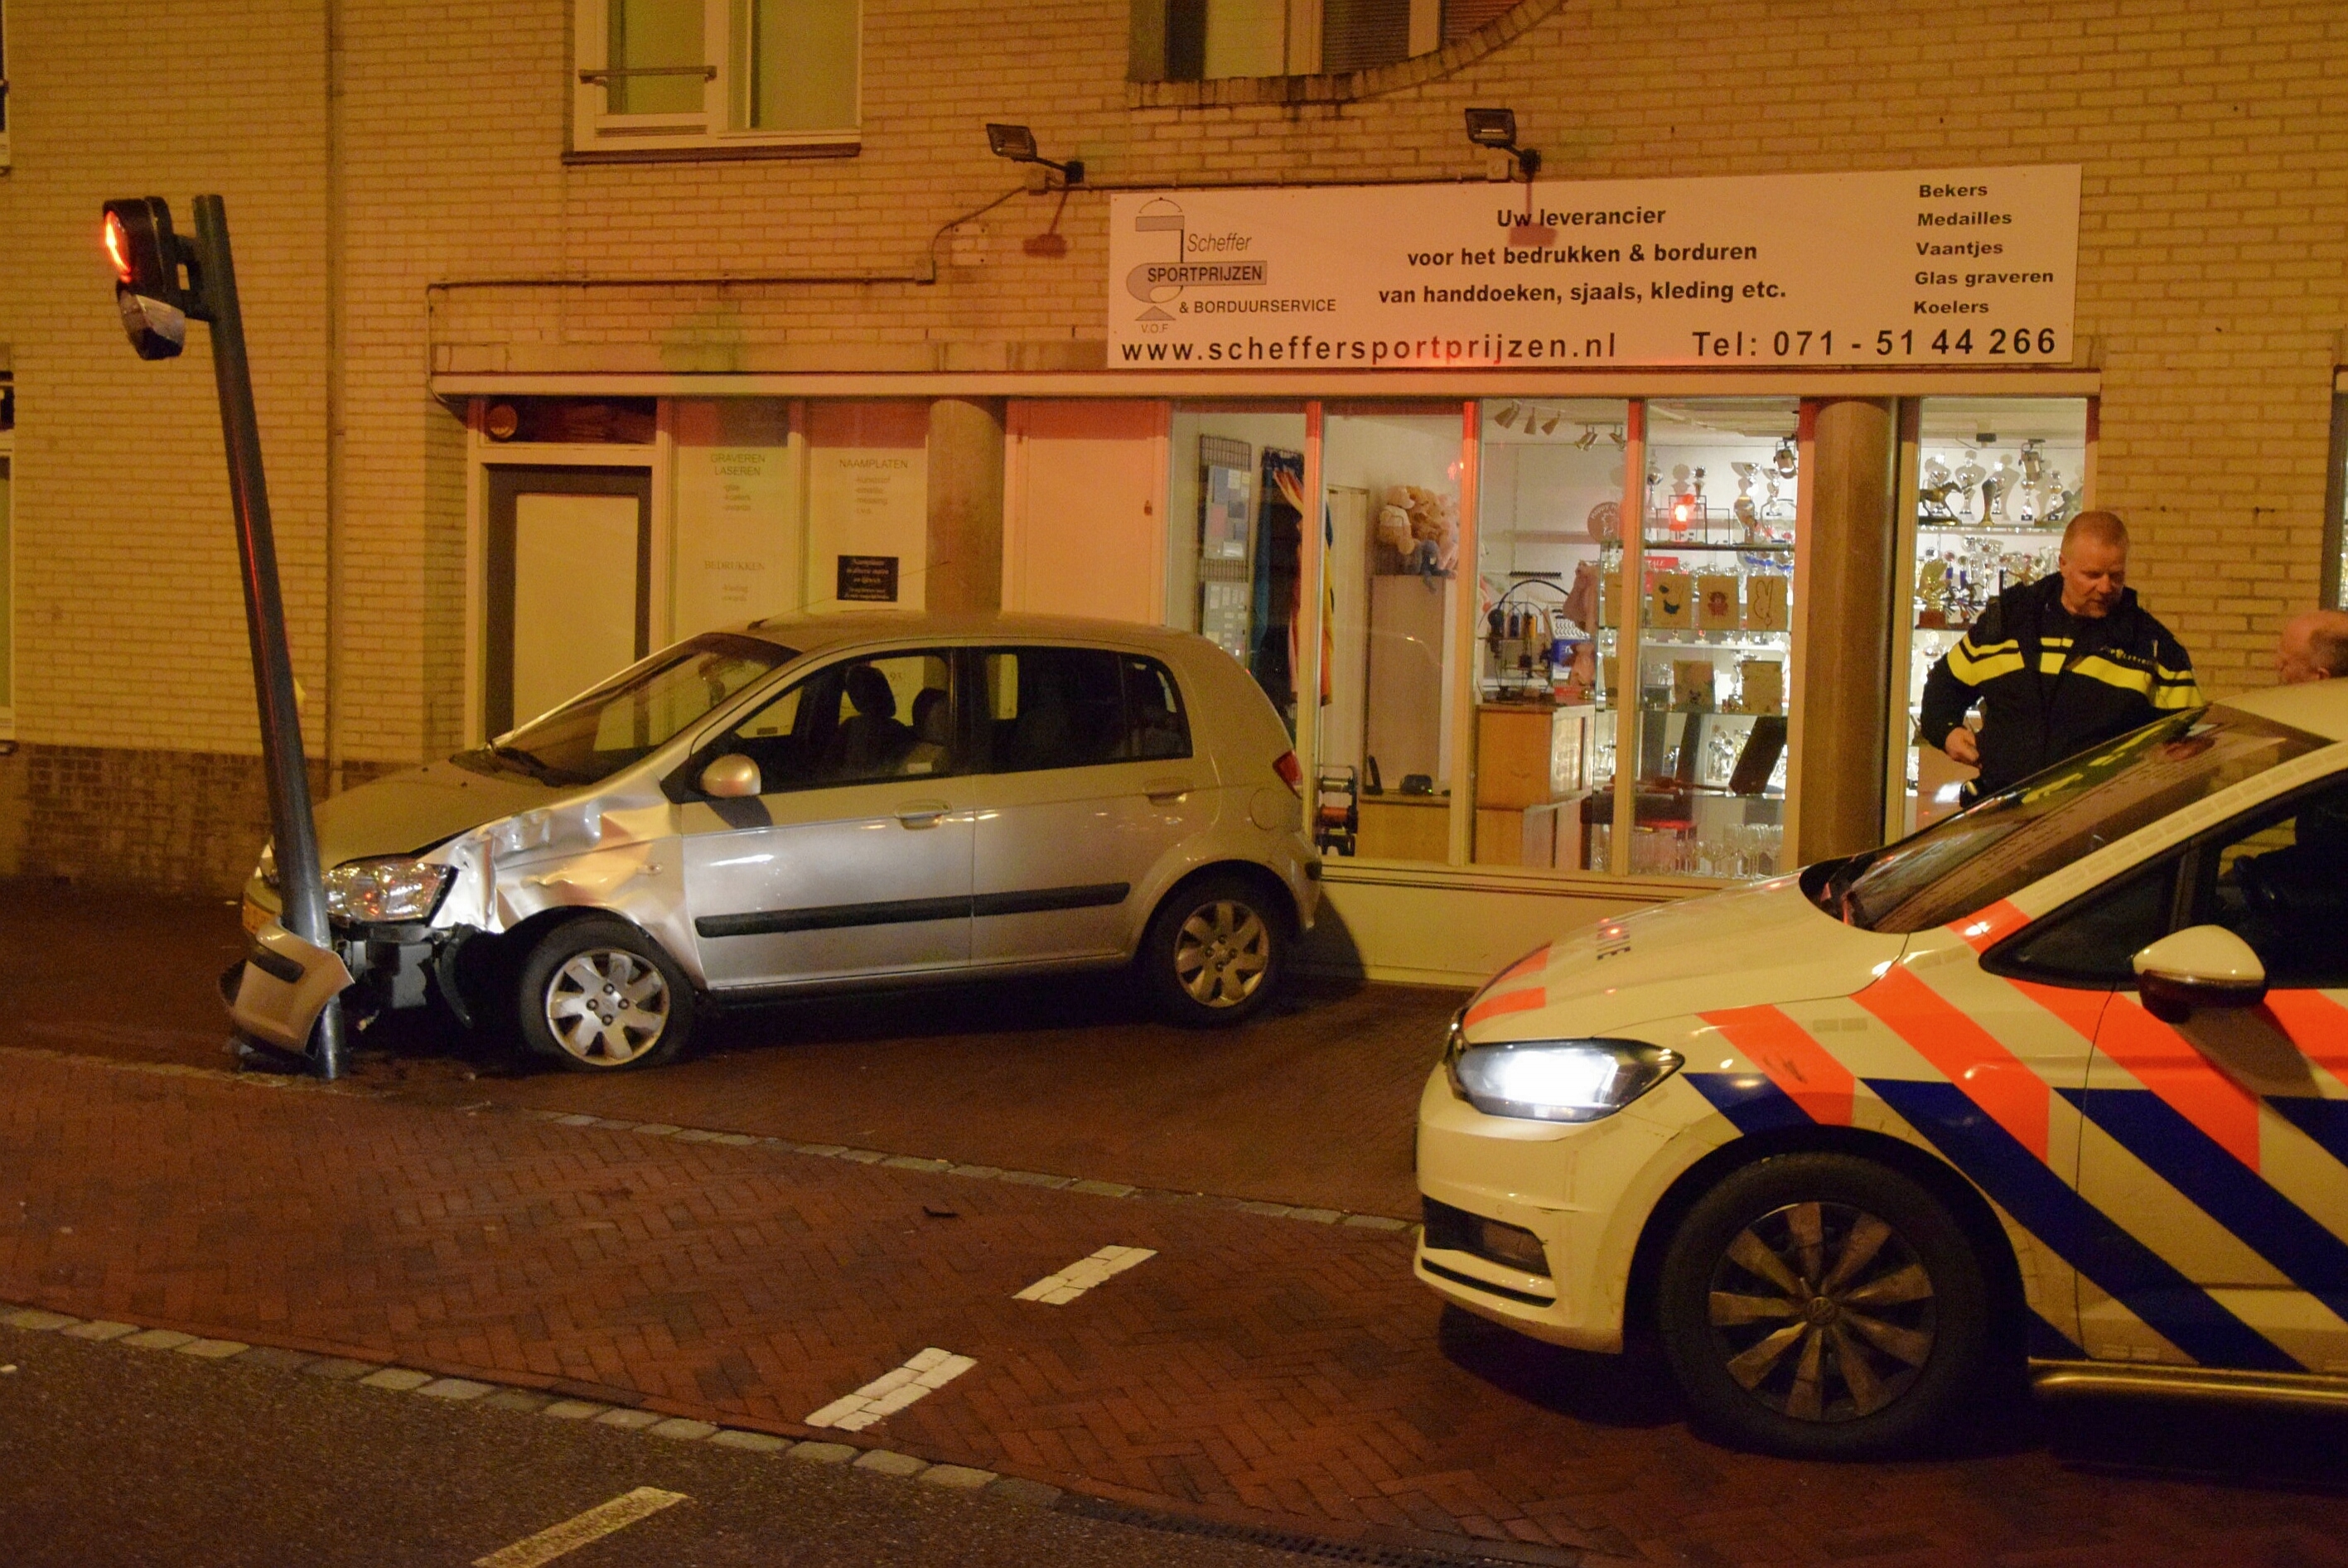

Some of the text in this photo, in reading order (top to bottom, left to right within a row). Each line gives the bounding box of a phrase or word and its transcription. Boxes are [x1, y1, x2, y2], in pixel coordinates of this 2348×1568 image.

[1920, 184, 1988, 198] Bekers
[1497, 207, 1666, 228] Uw leverancier
[1918, 211, 2012, 226] Medailles
[1187, 233, 1252, 252] Scheffer
[1916, 241, 2003, 258] Vaantjes
[1408, 243, 1756, 266] voor het bedrukken & borduren
[1148, 266, 1262, 282] SPORTPRIJZEN
[1916, 272, 2053, 287] Glas graveren
[1379, 281, 1785, 305] van handdoeken, sjaals, kleding etc.
[1179, 299, 1336, 313] & BORDUURSERVICE
[1914, 301, 1988, 314] Koelers
[1122, 332, 1616, 365] www.scheffersportprijzen.nl
[1693, 331, 1756, 356] Tel:
[1774, 330, 1831, 356] 071
[1877, 330, 1912, 355] 51
[1932, 329, 1973, 355] 44
[1989, 328, 2055, 354] 266
[710, 453, 766, 463] GRAVEREN
[839, 459, 909, 469] NAAMPLATEN
[714, 466, 761, 475] LASEREN
[704, 560, 766, 571] BEDRUKKEN
